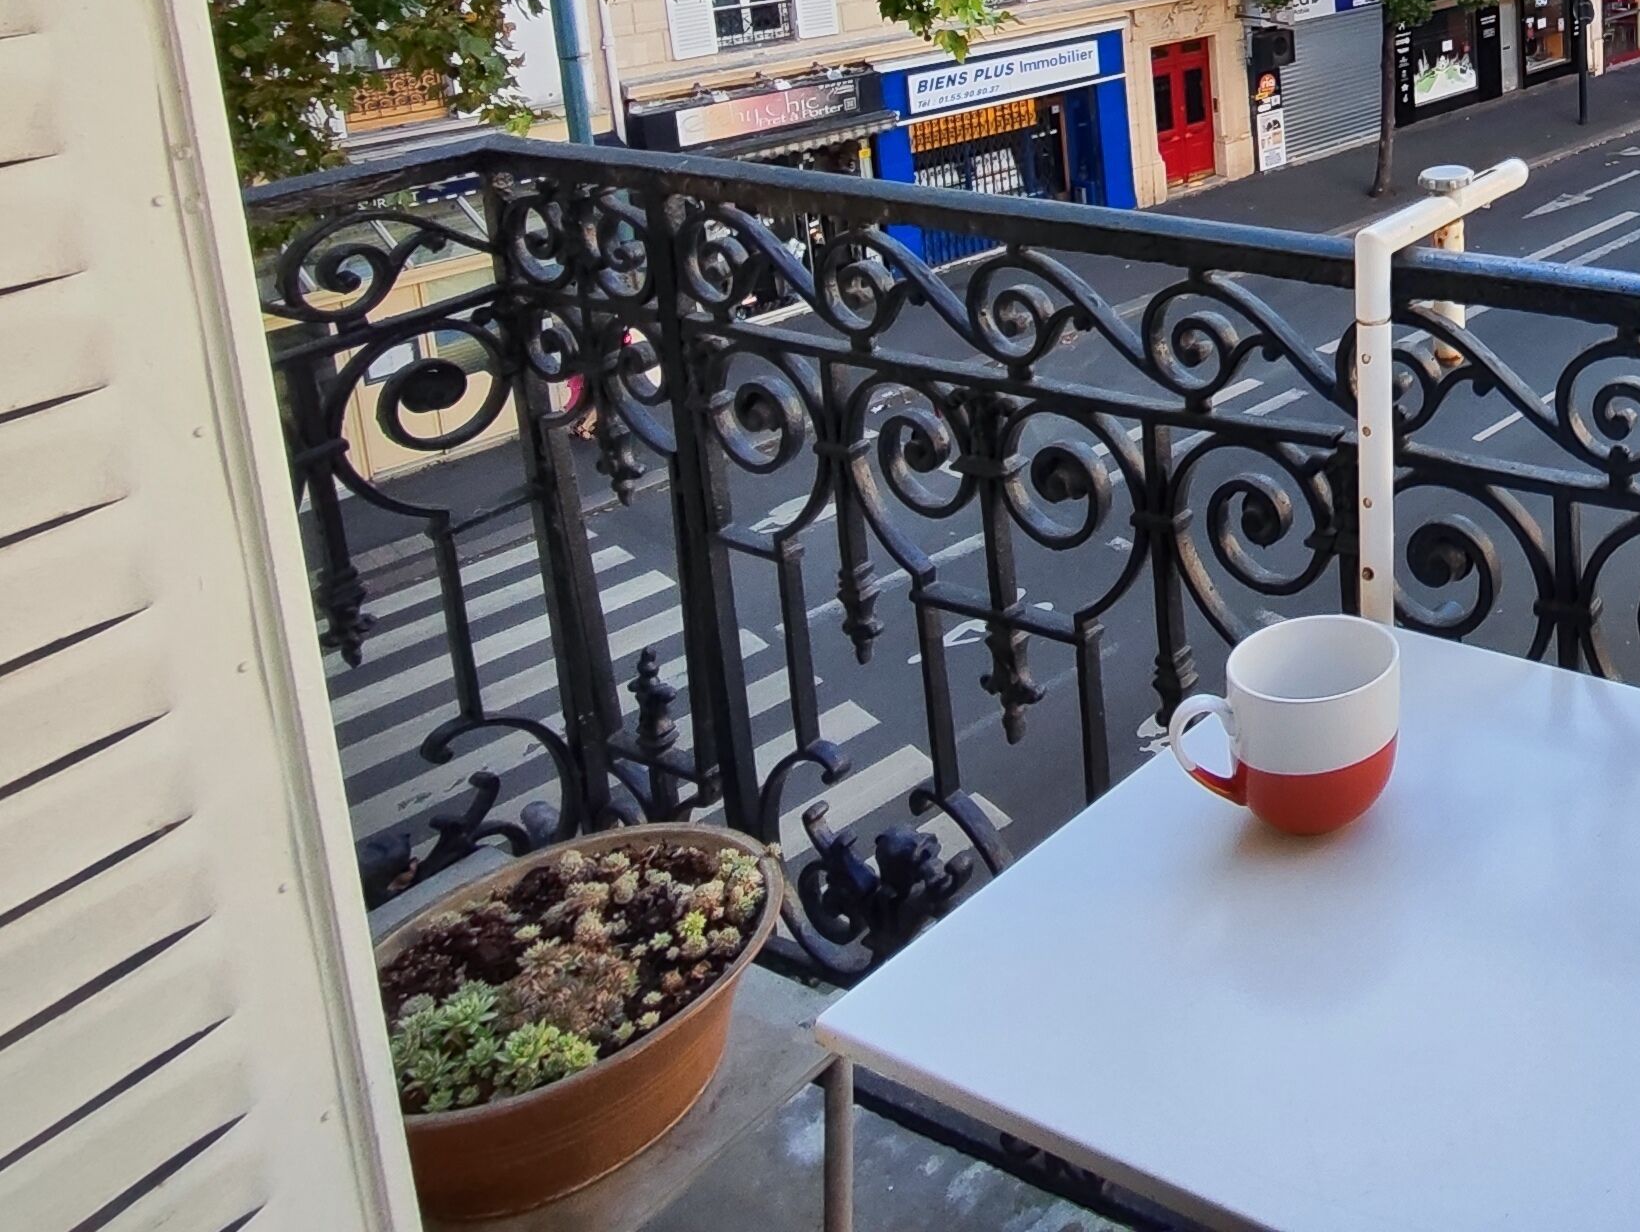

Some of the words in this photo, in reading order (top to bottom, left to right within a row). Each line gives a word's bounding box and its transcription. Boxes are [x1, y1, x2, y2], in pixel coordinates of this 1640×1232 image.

[916, 71, 968, 94] BIENS
[973, 62, 1015, 83] PLUS
[1019, 49, 1094, 73] Immobilier
[802, 103, 844, 120] Porter
